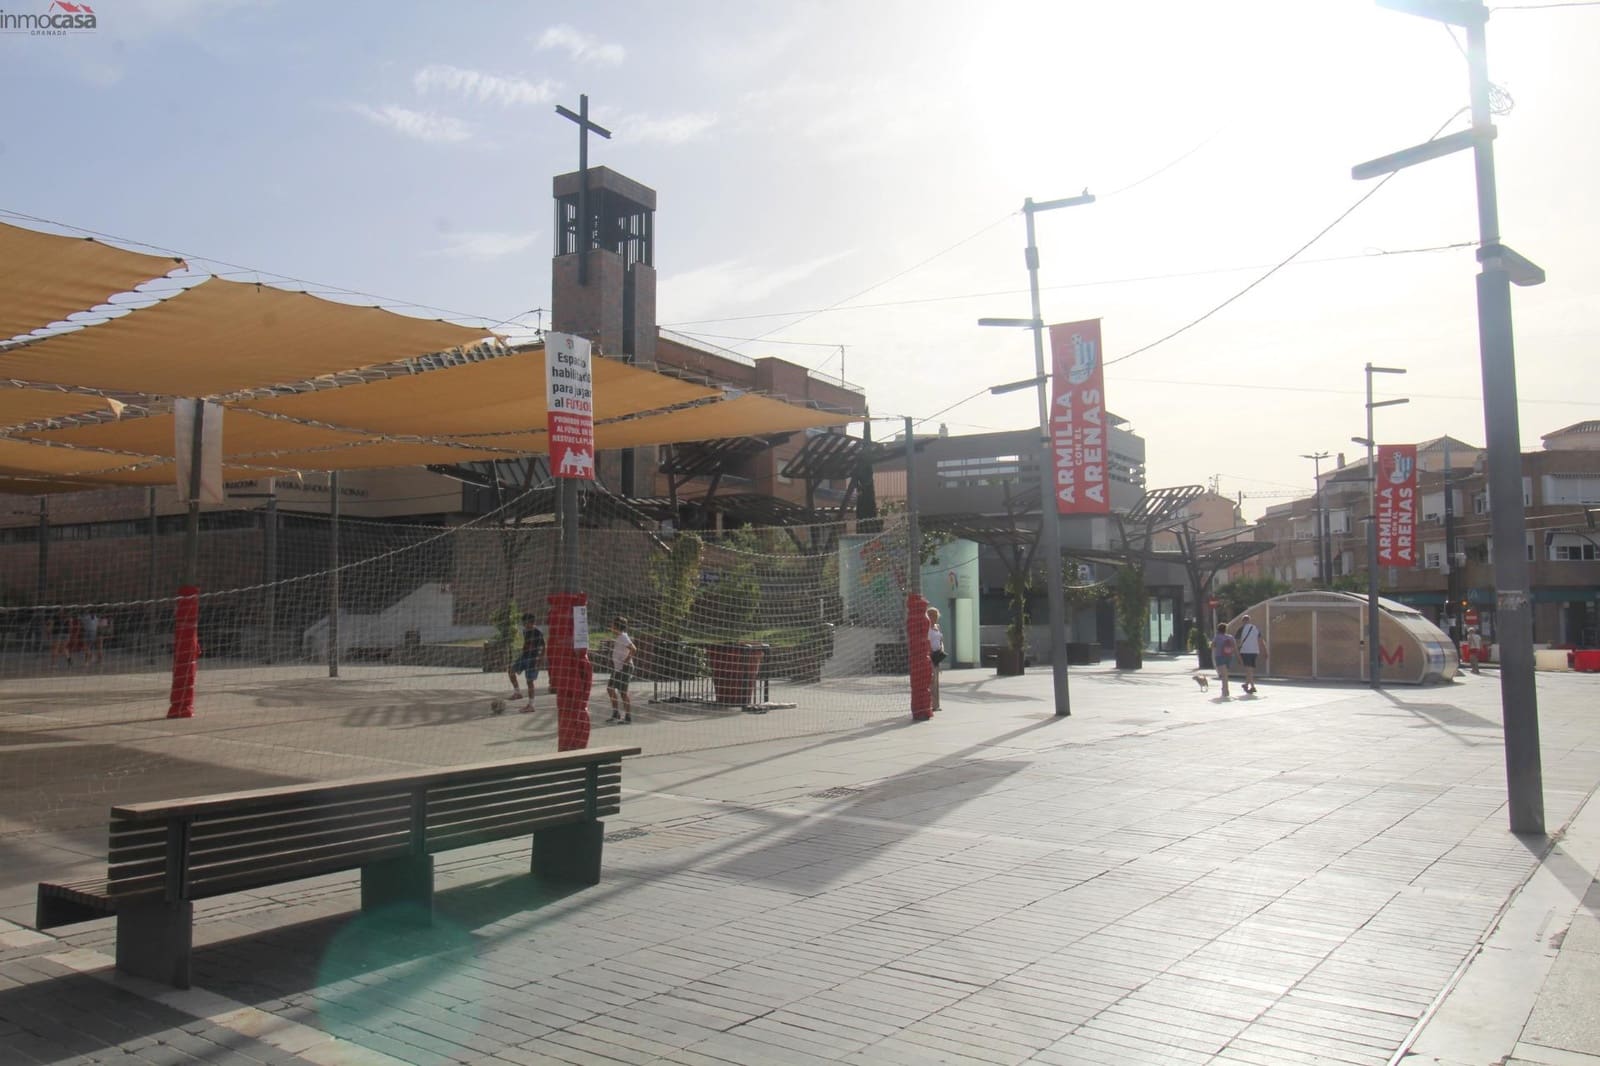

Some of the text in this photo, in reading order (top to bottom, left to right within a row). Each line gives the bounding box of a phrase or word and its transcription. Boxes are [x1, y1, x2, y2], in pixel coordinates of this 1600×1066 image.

[558, 352, 586, 368] Espacio
[552, 384, 573, 394] para
[554, 397, 564, 408] al
[1056, 391, 1075, 503] ARMILLA
[1075, 427, 1083, 465] CON EL
[1082, 389, 1104, 503] ARENAS
[1379, 487, 1392, 560] ARMILLA
[1398, 488, 1412, 560] ARENAS
